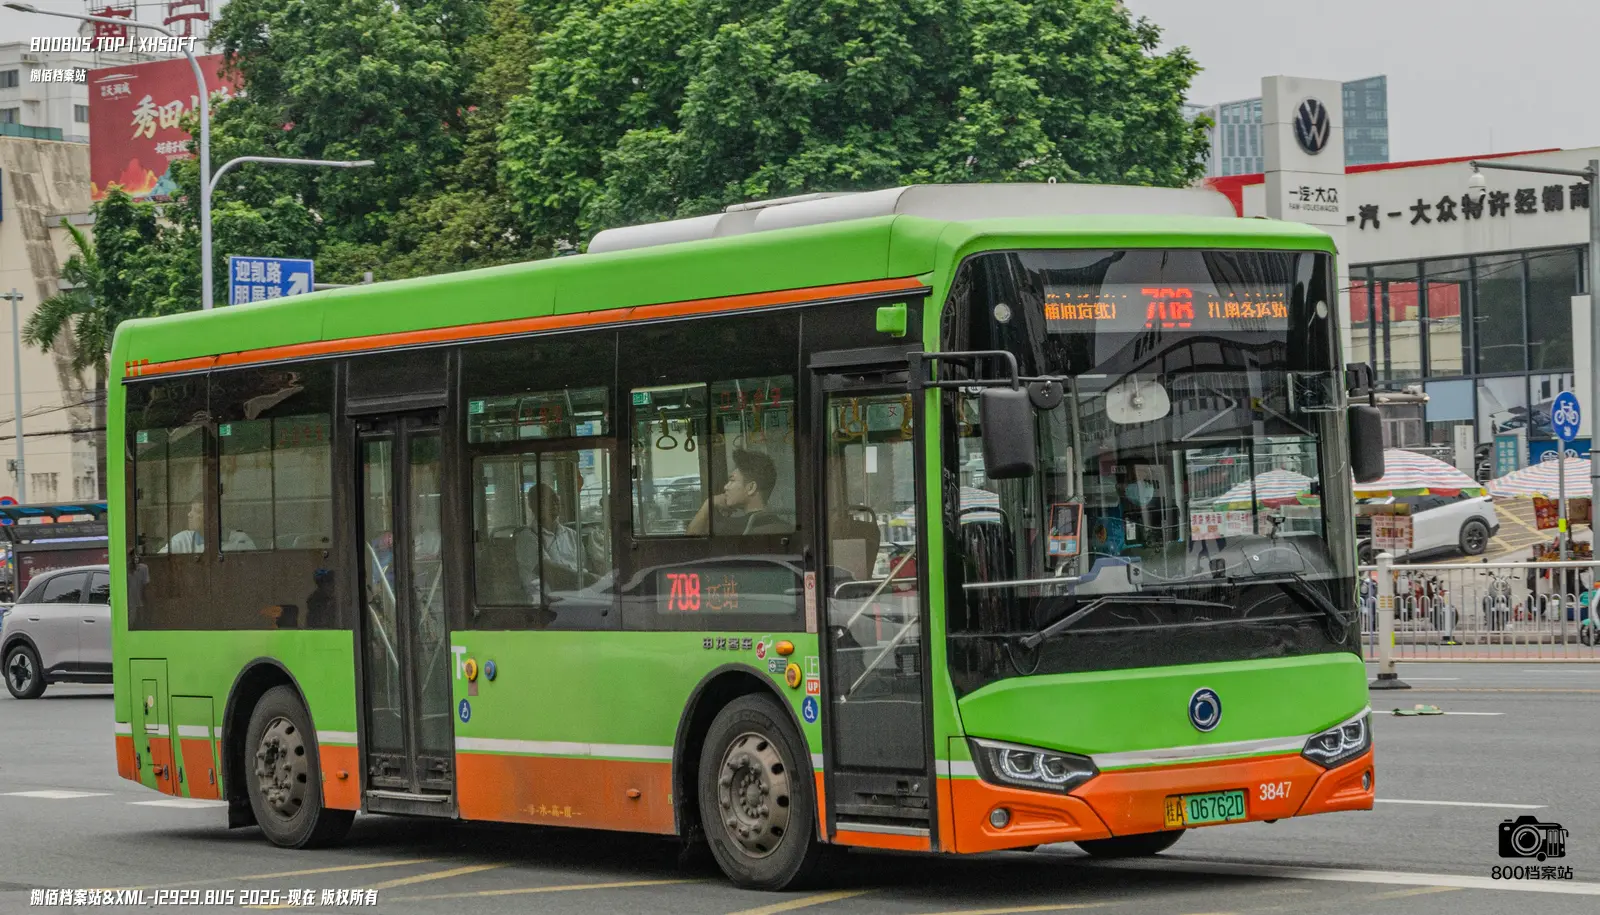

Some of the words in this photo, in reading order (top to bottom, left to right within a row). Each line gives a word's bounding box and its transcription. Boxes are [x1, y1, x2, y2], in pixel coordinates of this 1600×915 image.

[235, 260, 282, 284] 迎凯路
[666, 573, 701, 611] 708
[808, 682, 818, 692] UP
[1260, 781, 1292, 801] 3847
